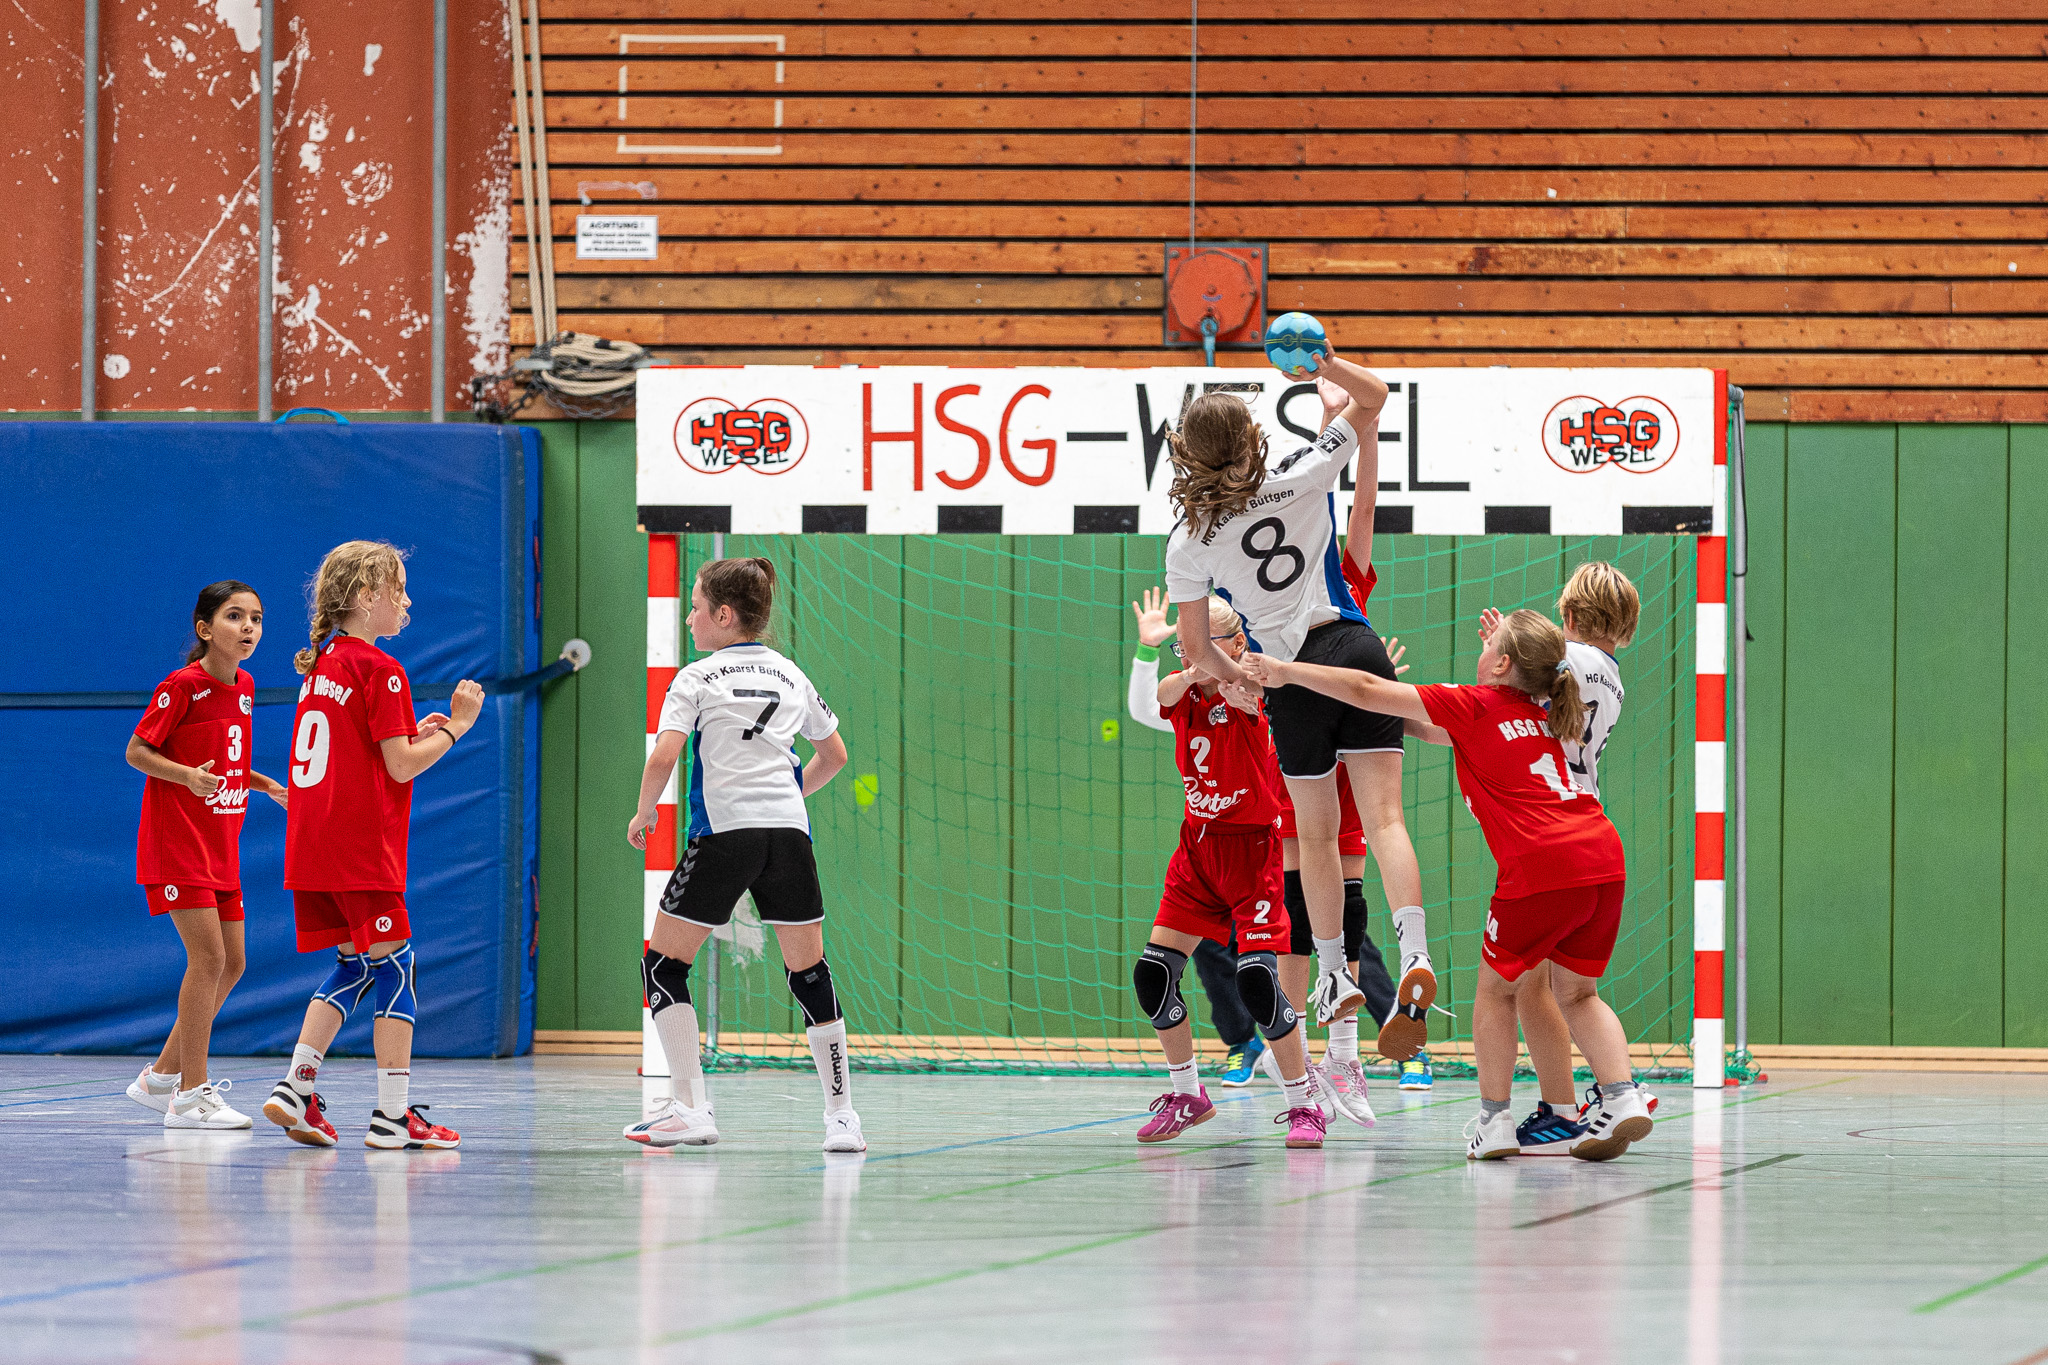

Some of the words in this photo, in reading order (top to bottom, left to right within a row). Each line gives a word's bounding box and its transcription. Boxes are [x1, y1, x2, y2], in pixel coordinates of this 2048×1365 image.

[690, 409, 792, 456] HSG
[1560, 406, 1661, 452] HSG
[701, 446, 789, 466] WESEL
[1570, 445, 1656, 466] WESEL
[1248, 489, 1295, 509] Büttgen
[1240, 516, 1306, 592] 8
[313, 674, 354, 707] Wesel
[719, 664, 756, 677] Kaarst
[758, 665, 795, 690] Büttgen
[1585, 672, 1599, 684] HG
[732, 688, 781, 741] 7
[1498, 718, 1540, 742] HSG
[227, 724, 243, 762] 3
[291, 710, 331, 789] 9
[1189, 736, 1211, 774] 2
[1253, 900, 1272, 924] 2
[1246, 931, 1272, 941] Kempa
[831, 1041, 843, 1097] Kempa
